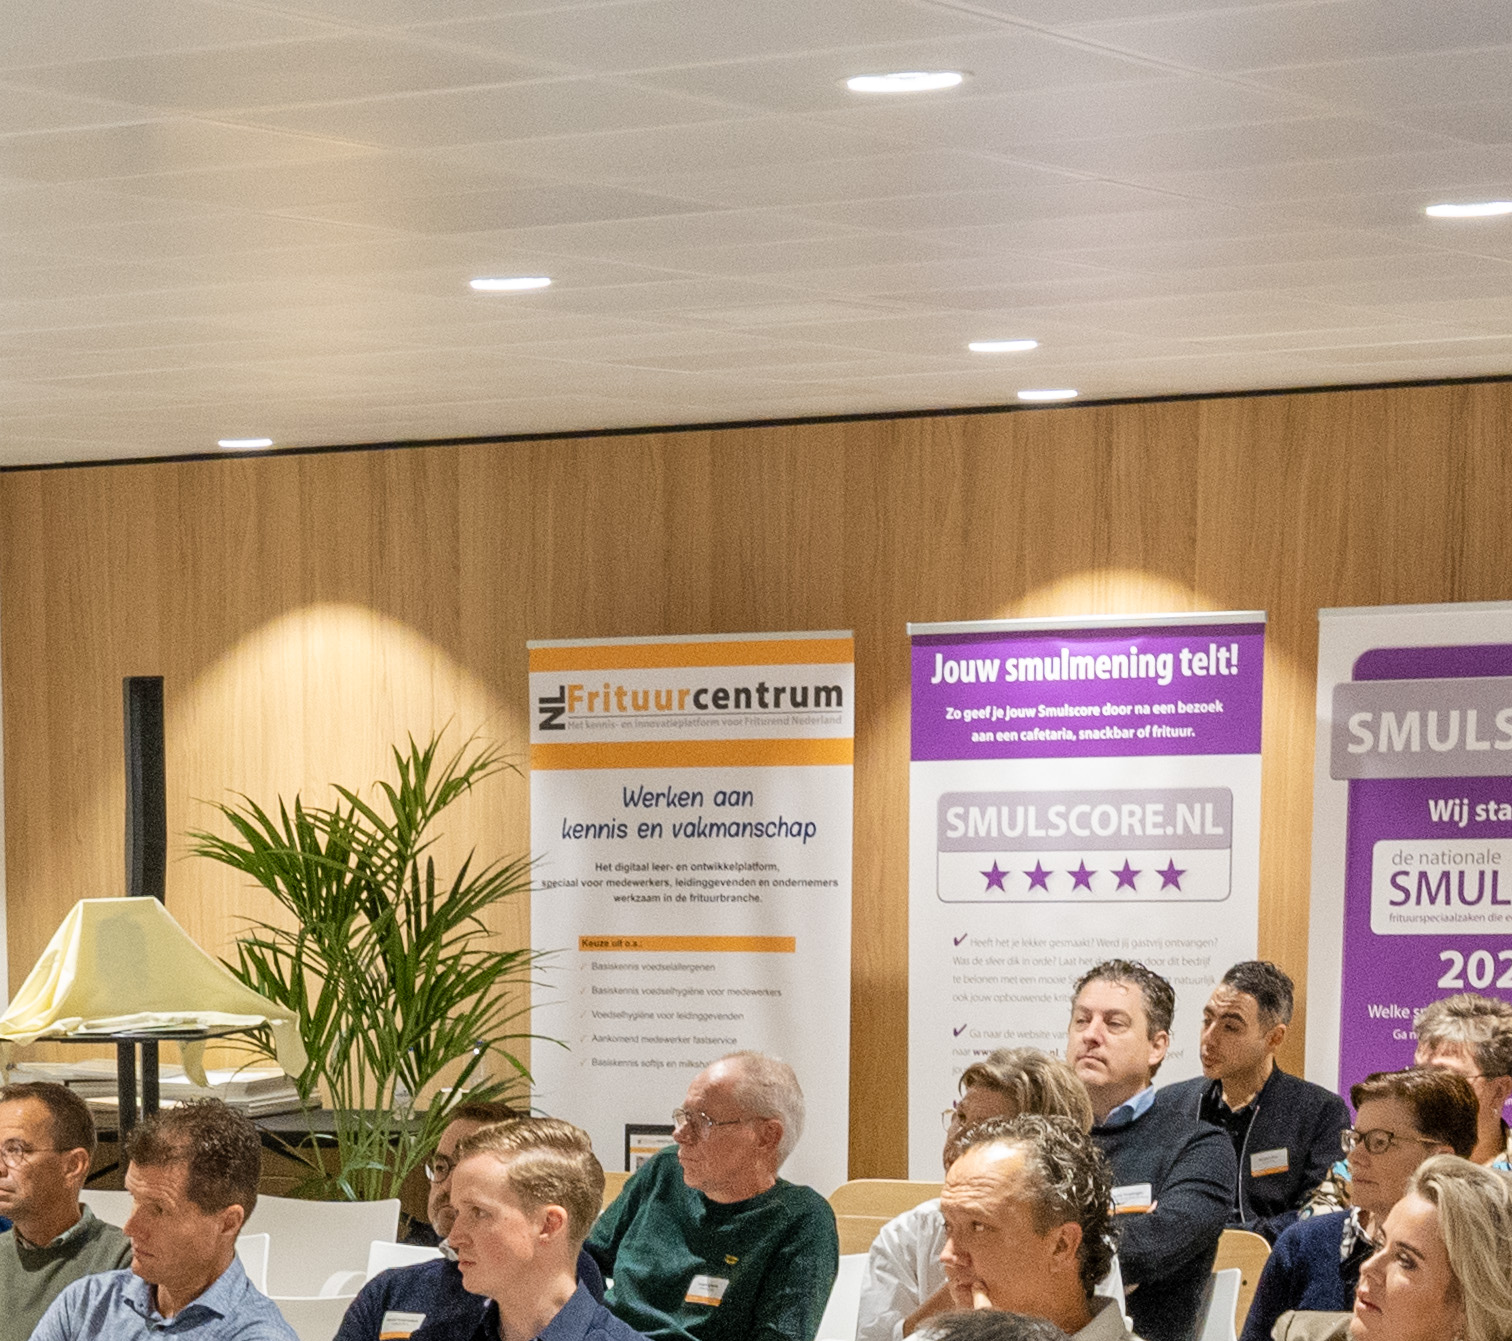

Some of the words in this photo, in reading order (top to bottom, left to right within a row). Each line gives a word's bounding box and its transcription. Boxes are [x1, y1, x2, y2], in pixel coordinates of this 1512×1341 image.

[931, 652, 1000, 685] Jouw
[1004, 646, 1174, 686] smulmening
[1179, 643, 1239, 677] telt!
[538, 685, 566, 731] NL
[567, 681, 843, 713] Frituurcentrum
[945, 707, 962, 720] Zo
[963, 706, 991, 722] geef
[992, 706, 1004, 721] je
[1005, 705, 1036, 721] jouw
[1037, 704, 1100, 718] Smulscore
[1102, 702, 1132, 716] door
[1134, 704, 1150, 715] na
[1152, 703, 1175, 714] een
[1177, 700, 1223, 714] bezoek
[971, 731, 994, 743] aan
[996, 730, 1018, 742] een
[1020, 727, 1077, 742] cafetaria,
[1078, 725, 1135, 741] snackbar
[1136, 725, 1151, 739] of
[1151, 725, 1196, 738] frituur.
[622, 785, 704, 809] Werken
[713, 787, 754, 807] aan
[946, 803, 1224, 838] SMULSCORE.NL
[1428, 799, 1469, 828] Wij
[562, 817, 628, 840] kennis
[637, 821, 662, 839] en
[672, 815, 817, 844] vakmanschap
[595, 862, 612, 872] Het
[615, 861, 649, 873] digitaal
[652, 862, 674, 872] leer-
[676, 863, 688, 872] en
[1391, 850, 1414, 866] de
[1419, 849, 1501, 866] nationale
[541, 877, 578, 889] speciaal
[581, 879, 603, 887] voor
[675, 877, 756, 889] leidinggevenden
[758, 879, 770, 887] en
[772, 878, 839, 888] ondernemers
[1367, 1004, 1411, 1020] Welke
